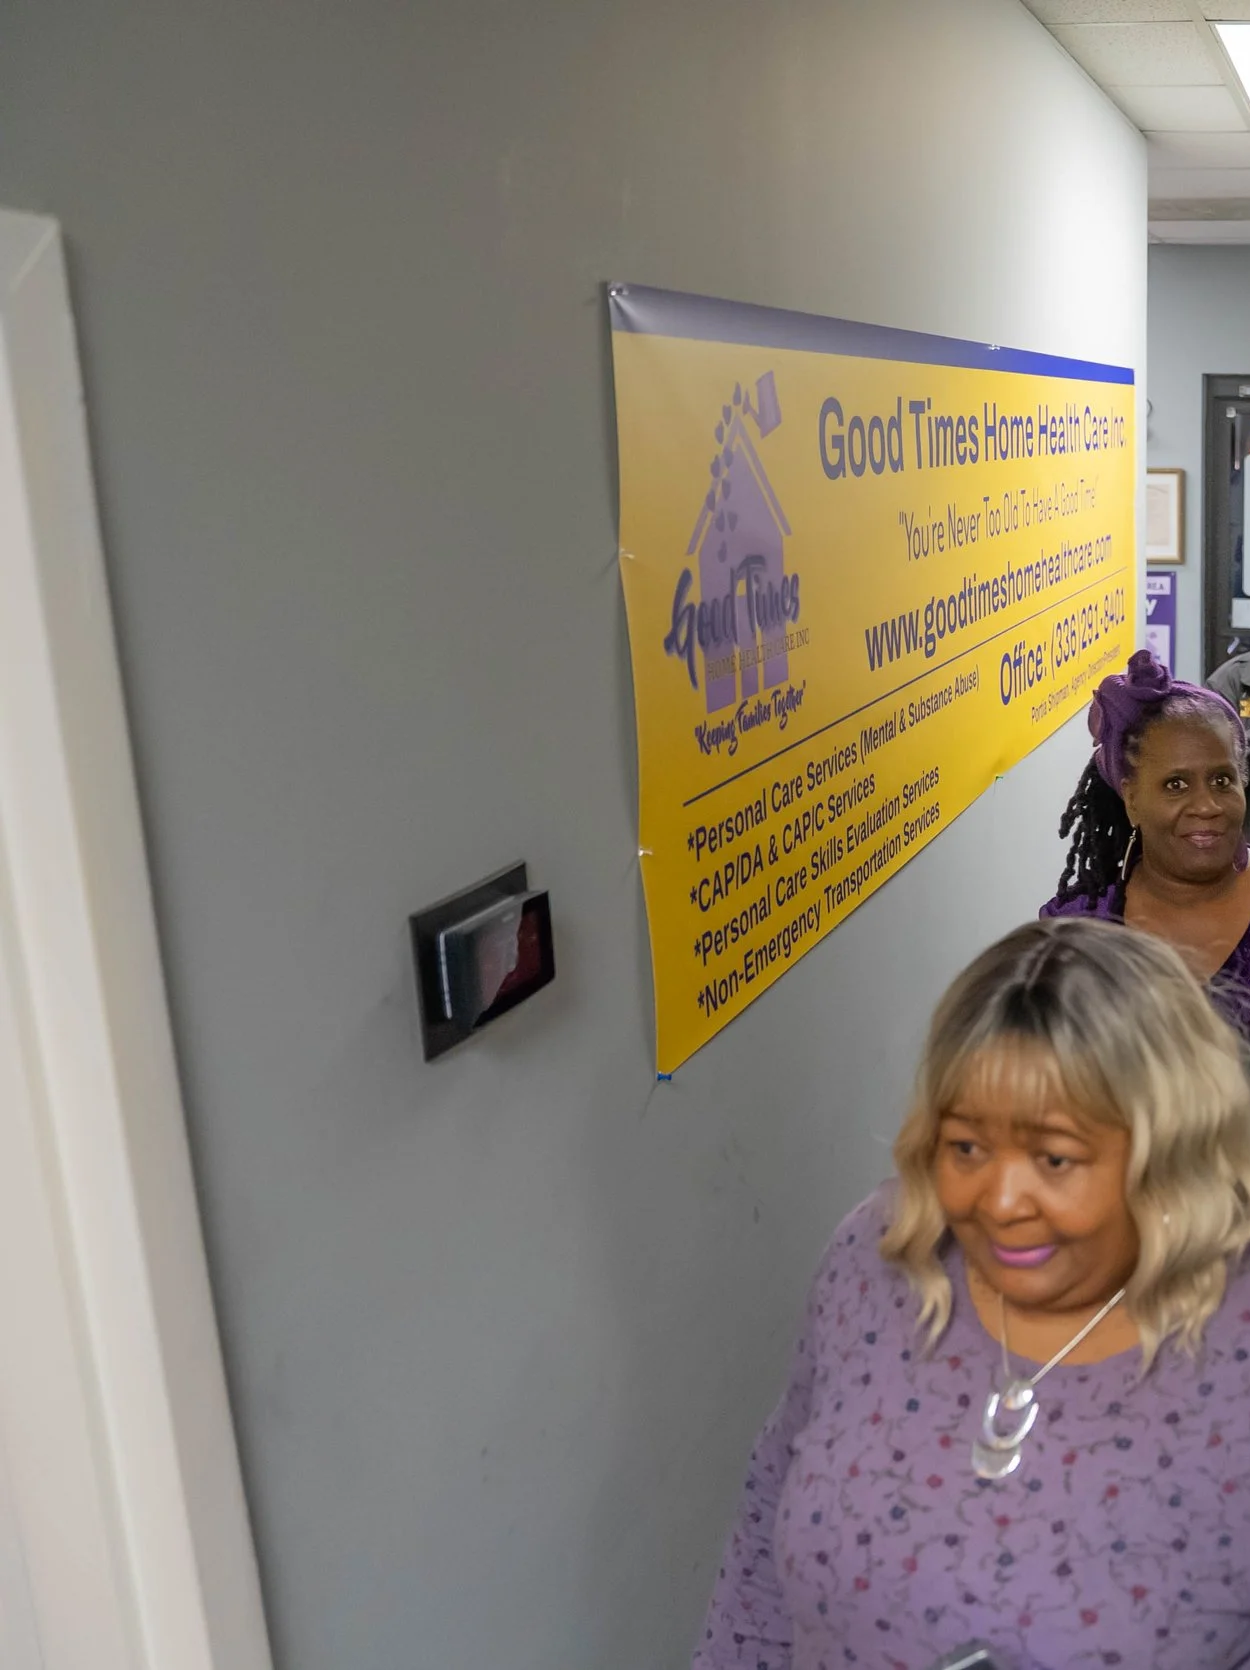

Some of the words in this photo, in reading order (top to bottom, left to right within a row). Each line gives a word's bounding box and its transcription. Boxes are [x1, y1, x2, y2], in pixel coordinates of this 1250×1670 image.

[819, 396, 904, 480] Good
[909, 397, 979, 470] Times
[984, 402, 1033, 462] Home
[1038, 402, 1080, 456] Health
[1083, 405, 1109, 451] Care
[1111, 407, 1127, 449] Inc.
[899, 505, 945, 561] "You're
[947, 502, 981, 549] Never
[983, 496, 1001, 538] Too
[1003, 490, 1019, 533] Old
[1020, 489, 1031, 528] To
[1033, 487, 1053, 525] Have
[1054, 483, 1060, 518] A
[1061, 477, 1079, 517] Good
[664, 567, 738, 690] Good
[737, 555, 800, 637] Times
[865, 534, 1112, 672] www.goodtimeshomehealthcare.com
[708, 655, 736, 681] HOME
[795, 627, 810, 650] INC
[1000, 640, 1047, 706] Office:
[736, 699, 771, 734] Families
[771, 775, 803, 813] Care
[807, 742, 857, 791] Services
[859, 711, 896, 765] (Mental
[899, 707, 906, 733] &
[908, 683, 953, 728] Substance
[954, 667, 980, 700] Abuse)
[768, 834, 779, 866] &
[782, 802, 825, 854] CAP/C
[827, 773, 876, 823] Services
[775, 868, 808, 908] Care
[810, 836, 844, 881] Skills
[847, 794, 900, 854] Evaluation
[902, 766, 940, 809] Services
[824, 833, 902, 914] Transportation
[903, 801, 940, 847] Services
